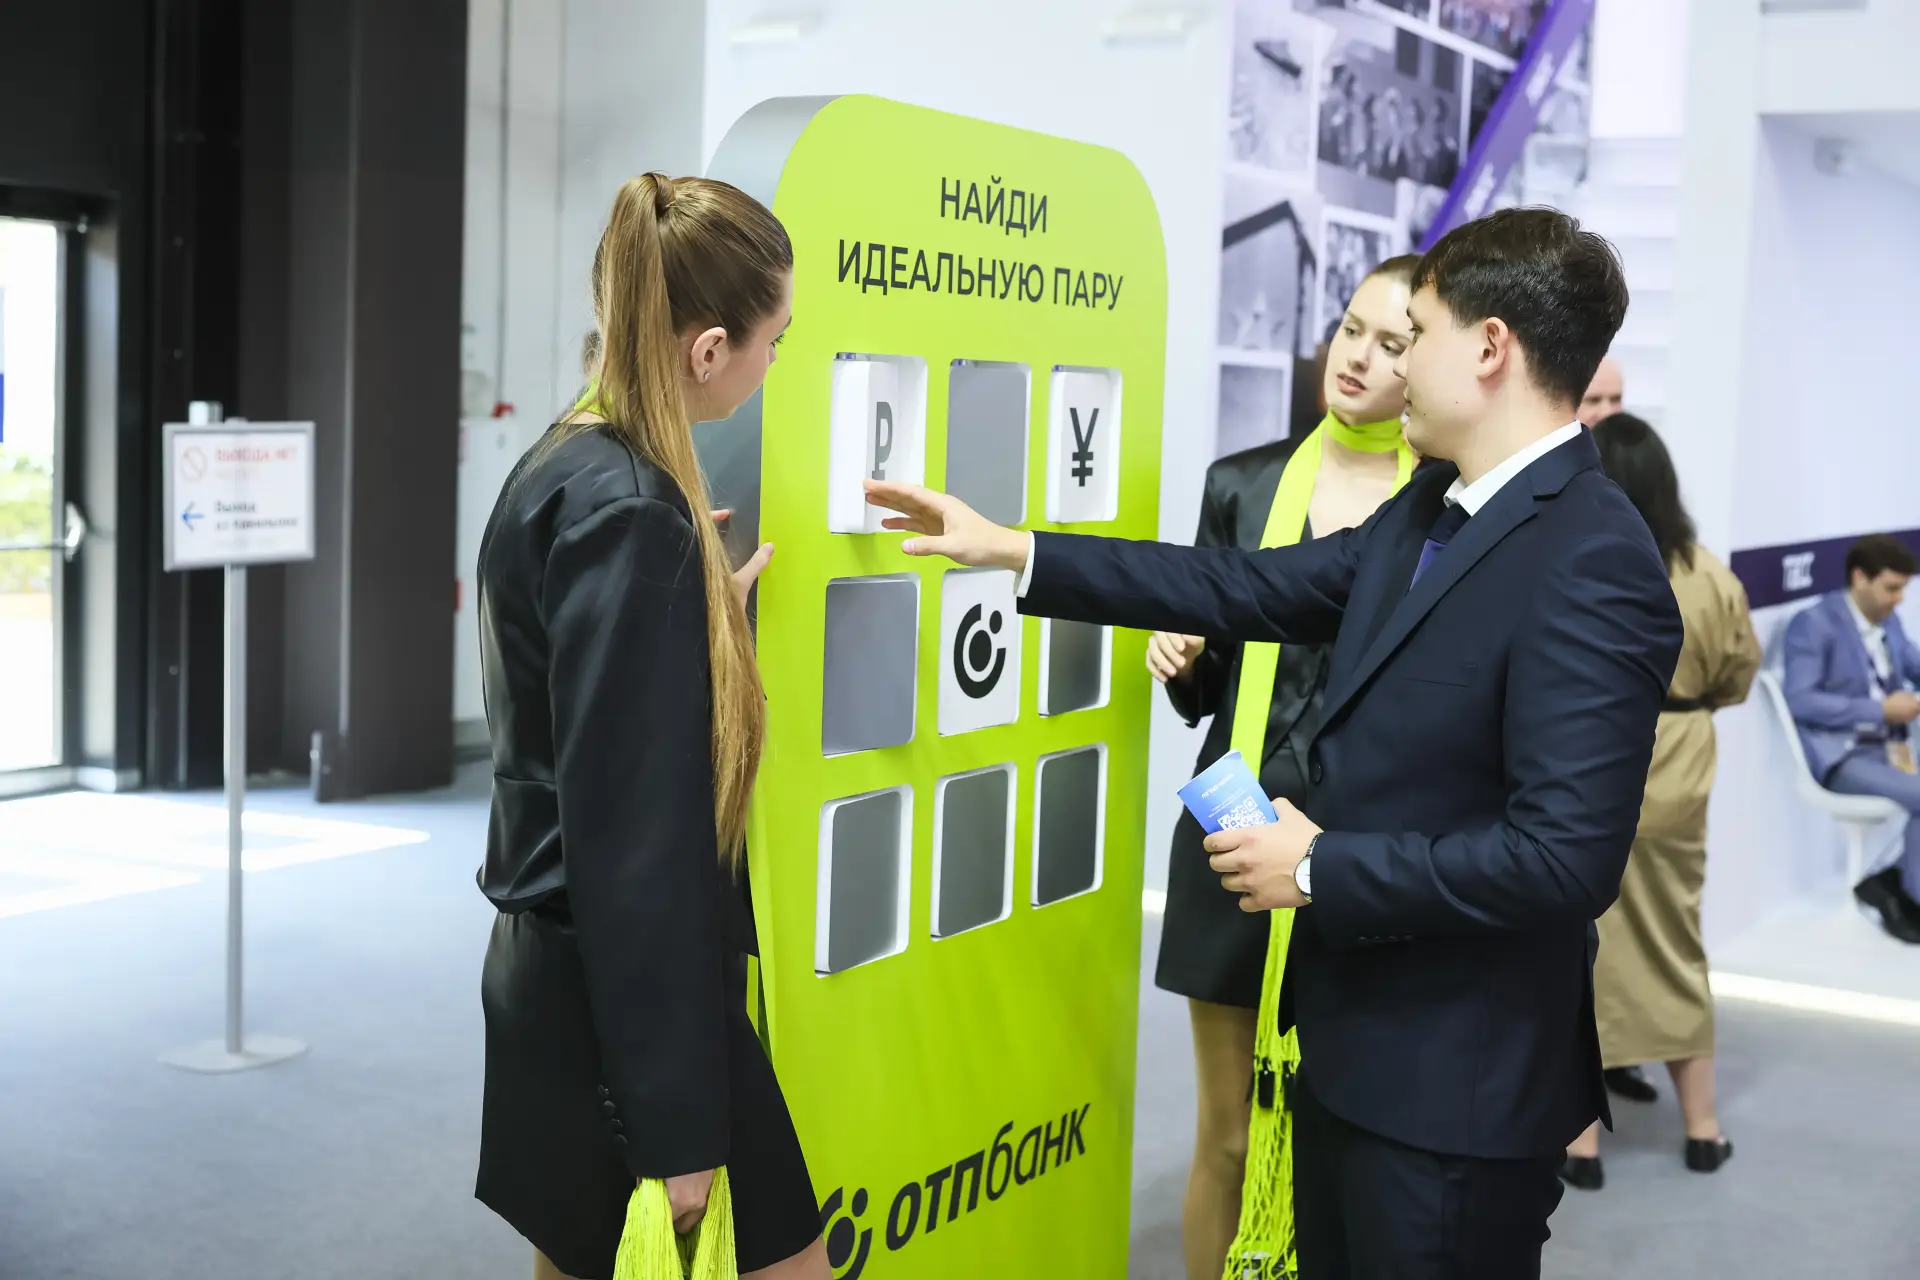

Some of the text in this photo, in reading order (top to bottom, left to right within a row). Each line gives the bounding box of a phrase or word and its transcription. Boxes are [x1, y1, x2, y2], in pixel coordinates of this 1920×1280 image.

[940, 174, 1047, 238] НАЙДИ
[838, 239, 1123, 311] ИДЕАЛЬНУЮ ПАРУ
